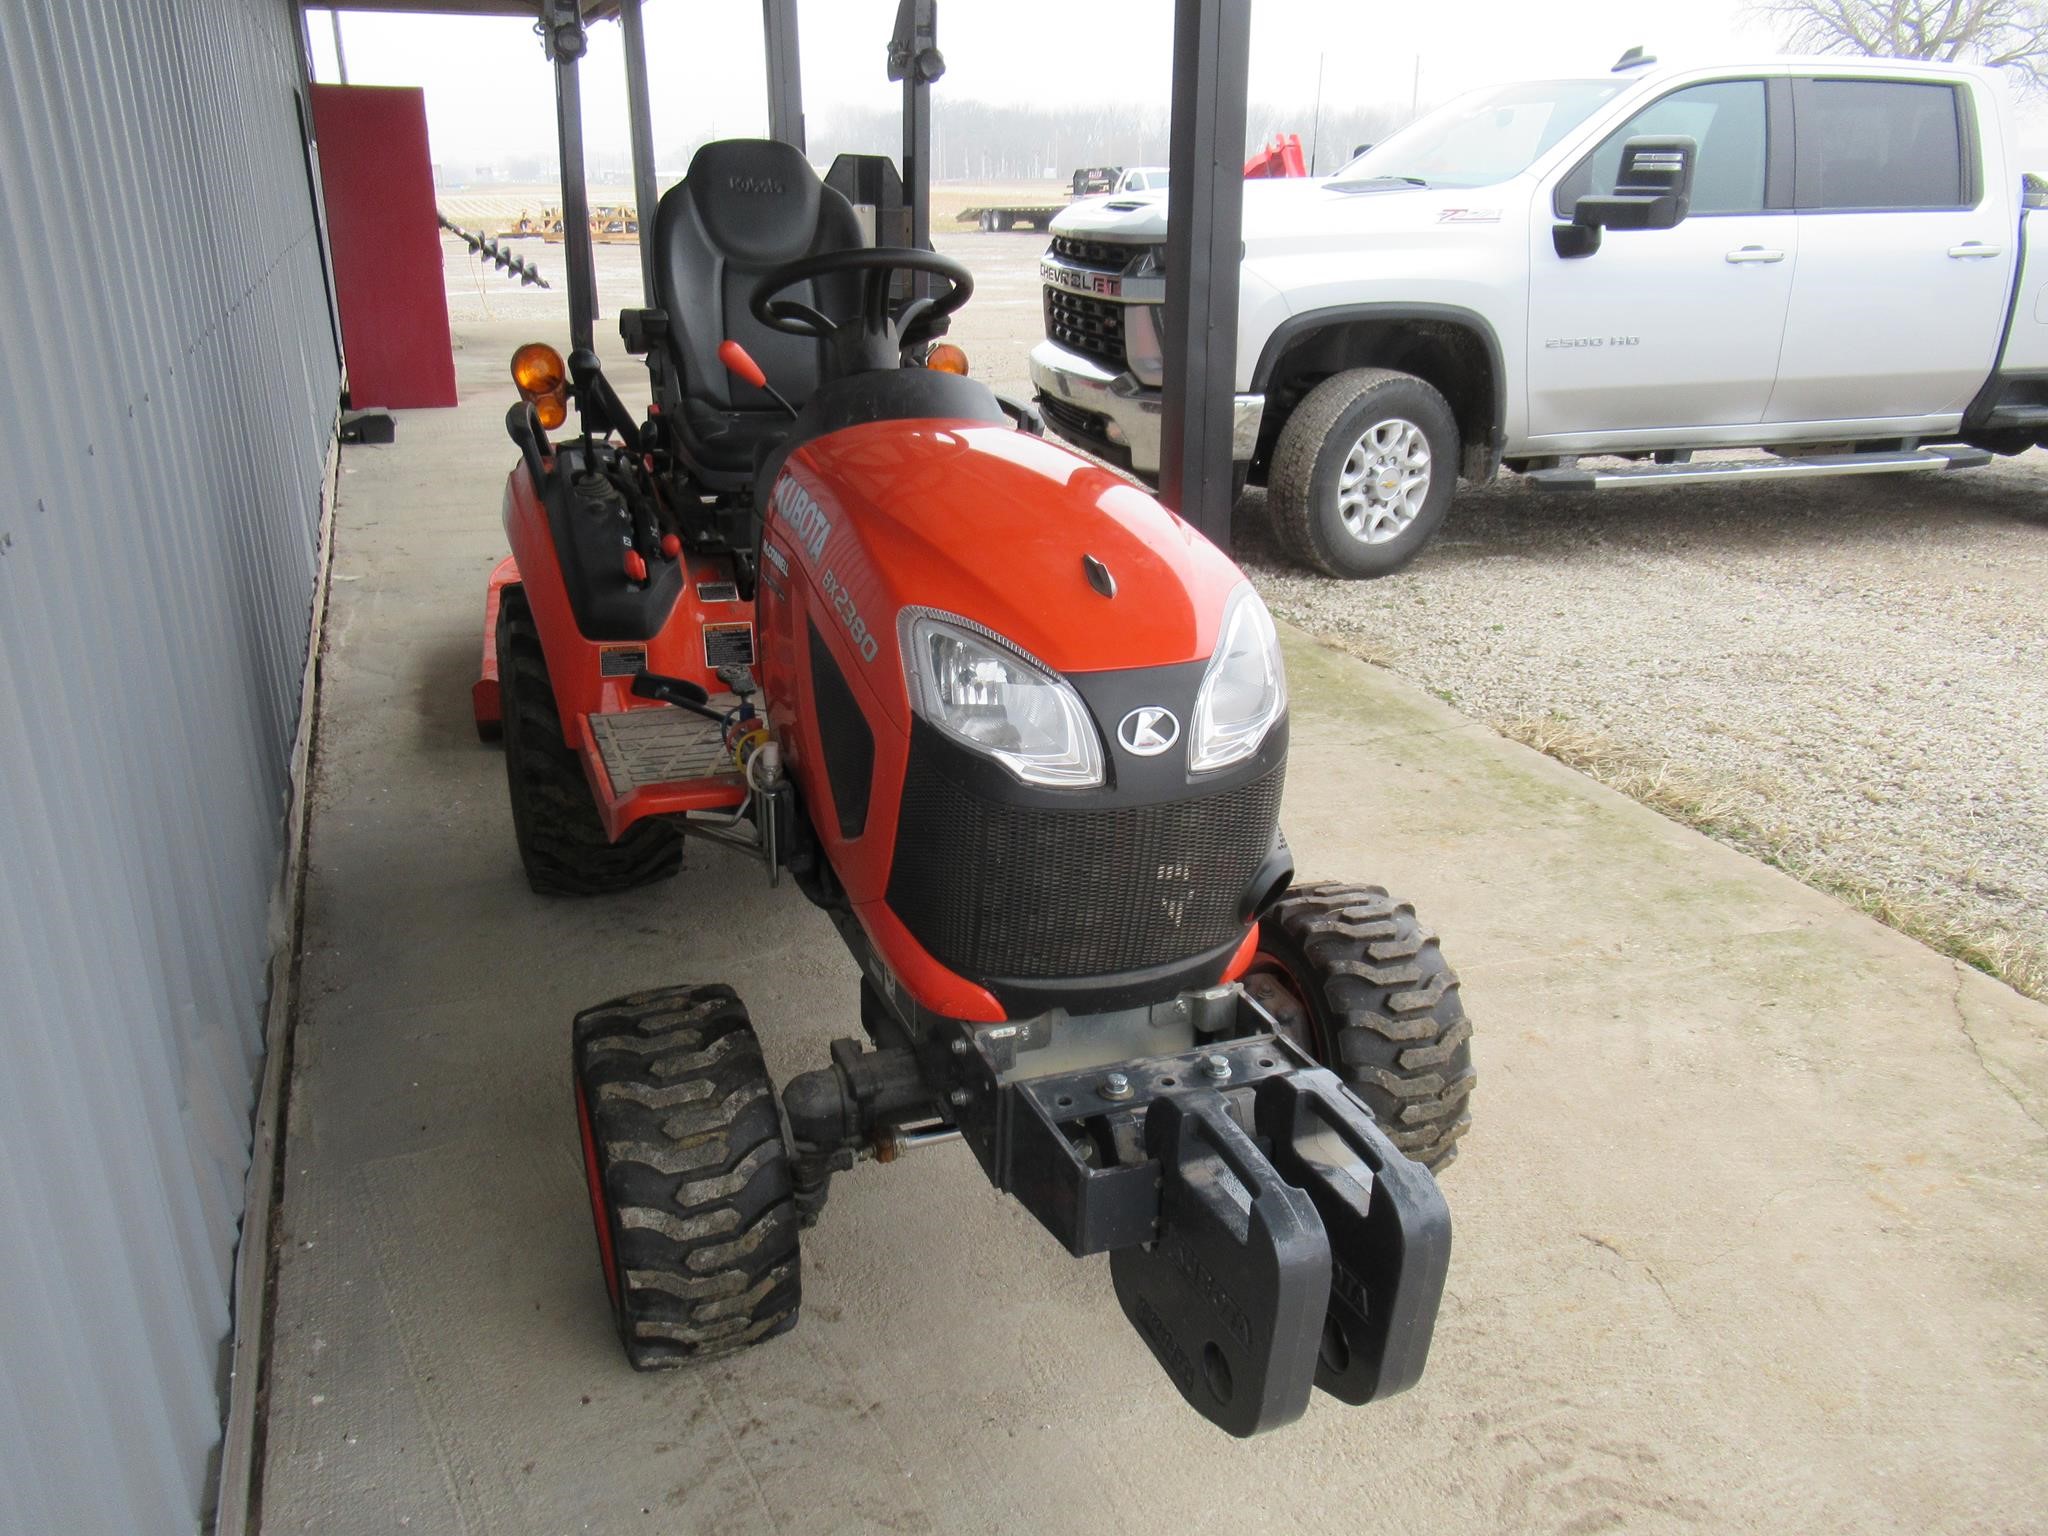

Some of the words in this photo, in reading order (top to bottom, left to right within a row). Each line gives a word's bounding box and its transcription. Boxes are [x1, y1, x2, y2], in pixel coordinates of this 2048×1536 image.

[1040, 263, 1121, 296] CHEVROLET
[1544, 337, 1603, 349] 2500
[1609, 335, 1640, 346] HD
[775, 474, 832, 566] KUBOTA
[822, 568, 879, 663] BX2380
